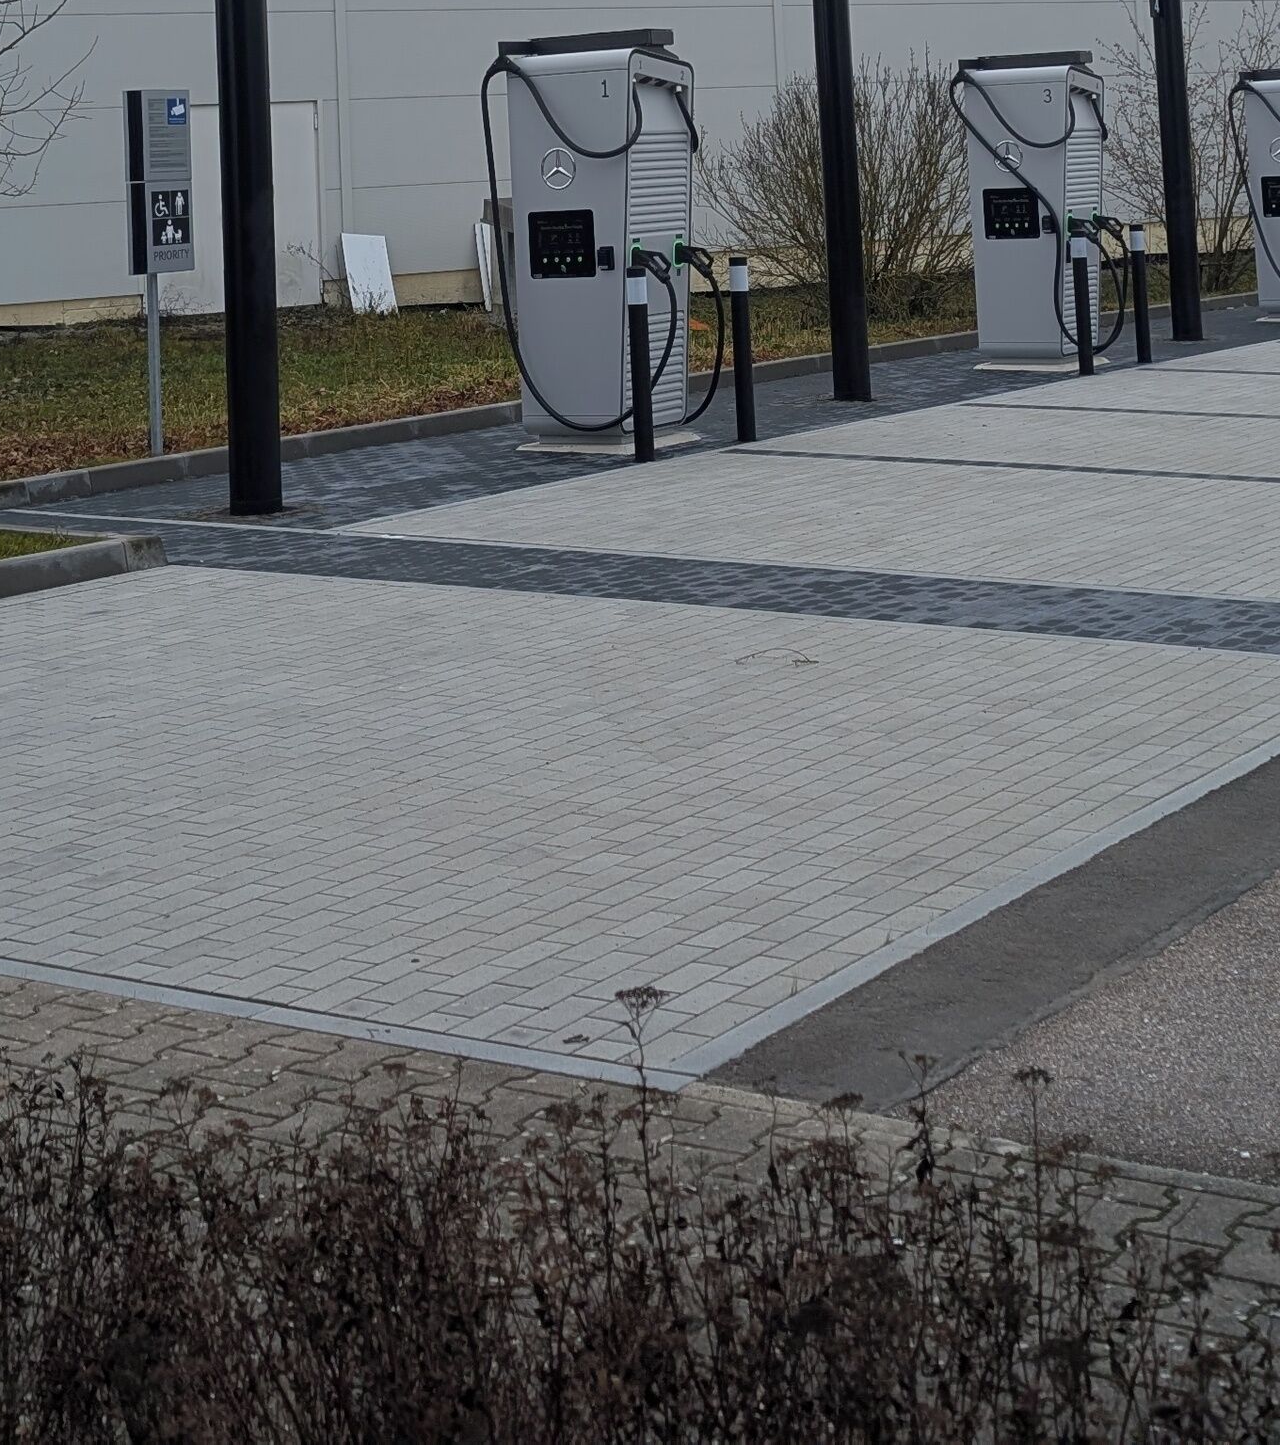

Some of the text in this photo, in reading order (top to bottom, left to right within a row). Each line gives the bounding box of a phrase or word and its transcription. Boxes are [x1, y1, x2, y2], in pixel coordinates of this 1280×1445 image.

[601, 79, 610, 98] 1
[1043, 88, 1053, 103] 3
[153, 249, 190, 262] PRIORITY
